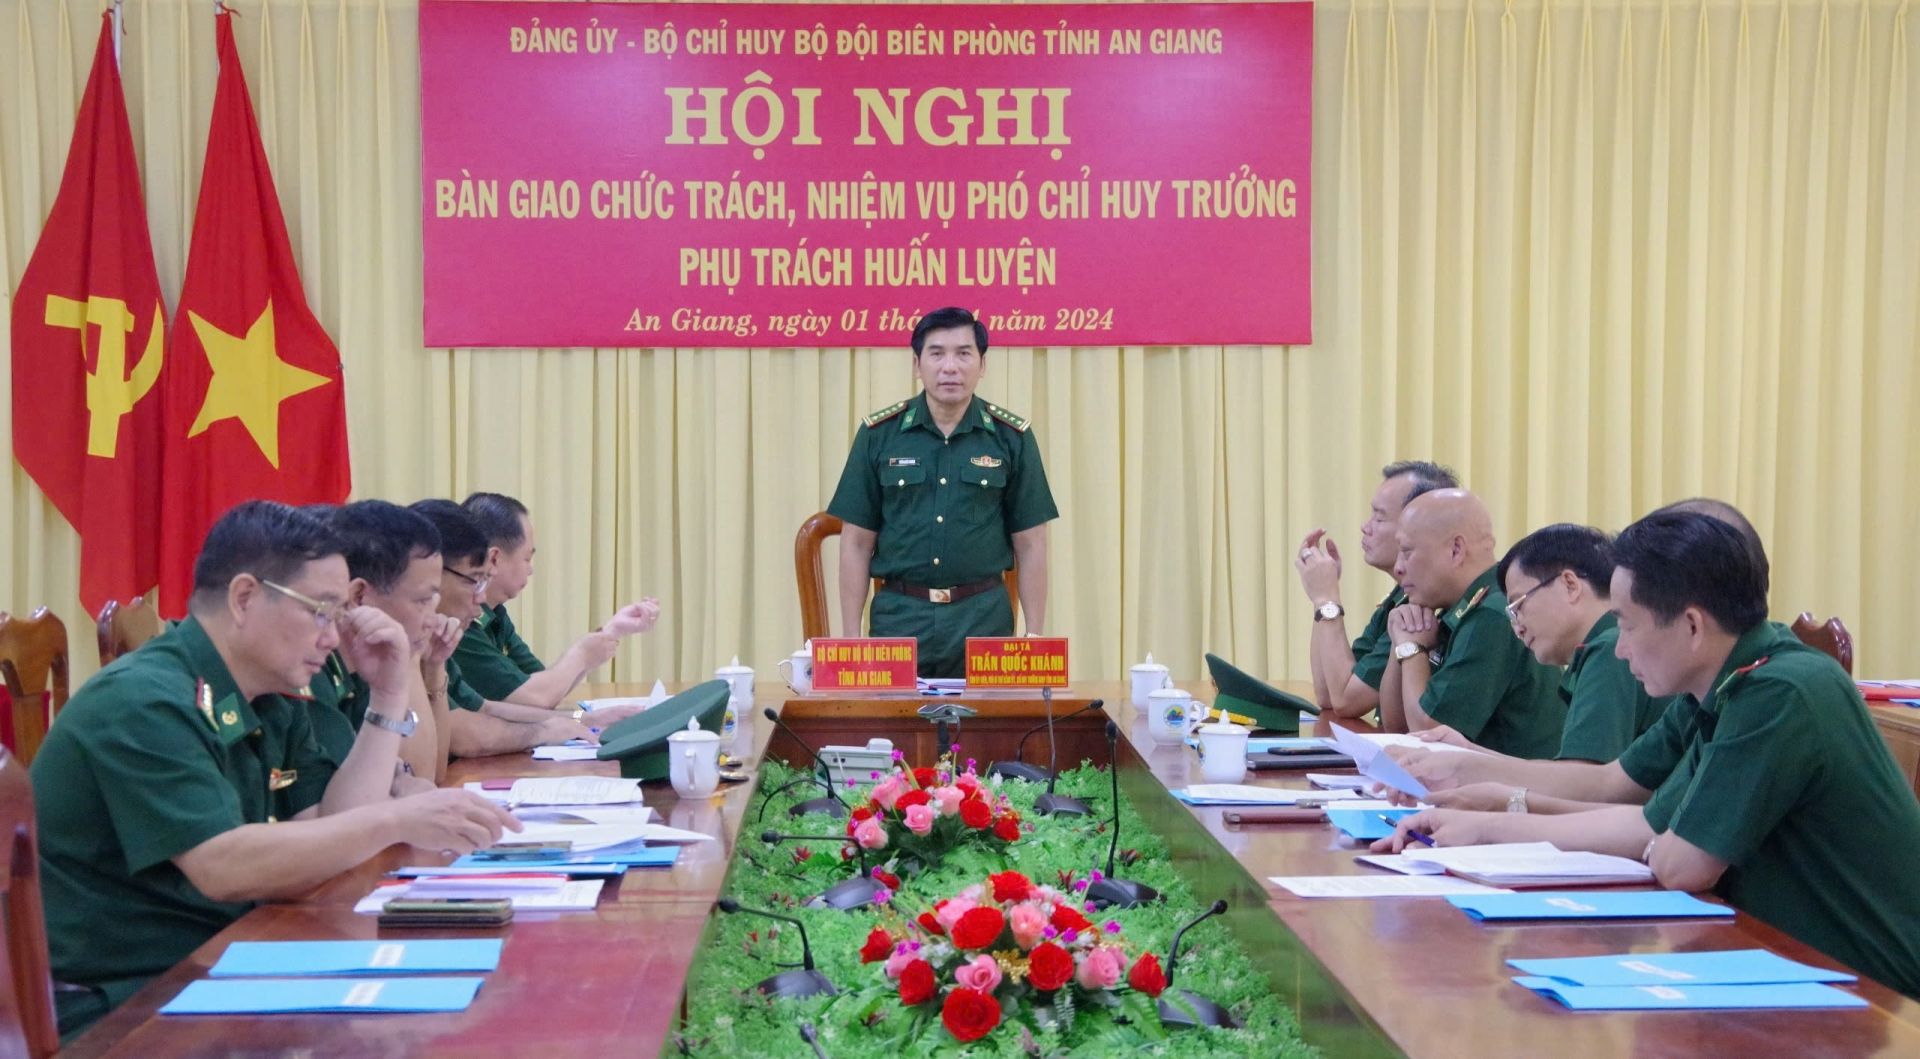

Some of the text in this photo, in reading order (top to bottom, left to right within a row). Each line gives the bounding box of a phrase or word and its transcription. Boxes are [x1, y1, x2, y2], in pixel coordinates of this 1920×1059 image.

[509, 16, 578, 54] ĐẢNG
[585, 17, 619, 55] ỦY
[643, 21, 679, 61] BỘ
[685, 18, 728, 55] CHỈ
[736, 29, 786, 55] HUY
[794, 22, 829, 61] BỘ
[835, 22, 878, 61] ĐỘI
[887, 22, 945, 56] BIÊN
[953, 23, 1036, 56] PHÒNG
[1042, 19, 1101, 56] TỈNH
[1108, 29, 1142, 55] AN
[1149, 28, 1223, 55] GIANG
[663, 69, 1072, 161] HỘI NGHỊ
[435, 163, 1297, 229] BÀN GIAO CHỨC TRÁCH, NHIỆM VỤ PHÓ CHỈ HUY TRƯỞNG
[679, 232, 1056, 296] PHỤ TRÁCH HUẤN LUYỆN
[623, 307, 662, 332] An
[671, 307, 758, 337] Giang,
[767, 308, 832, 337] ngày
[840, 308, 869, 332] 01
[878, 307, 923, 332] thá
[988, 309, 1047, 331] năm
[1054, 307, 1114, 331] 2024
